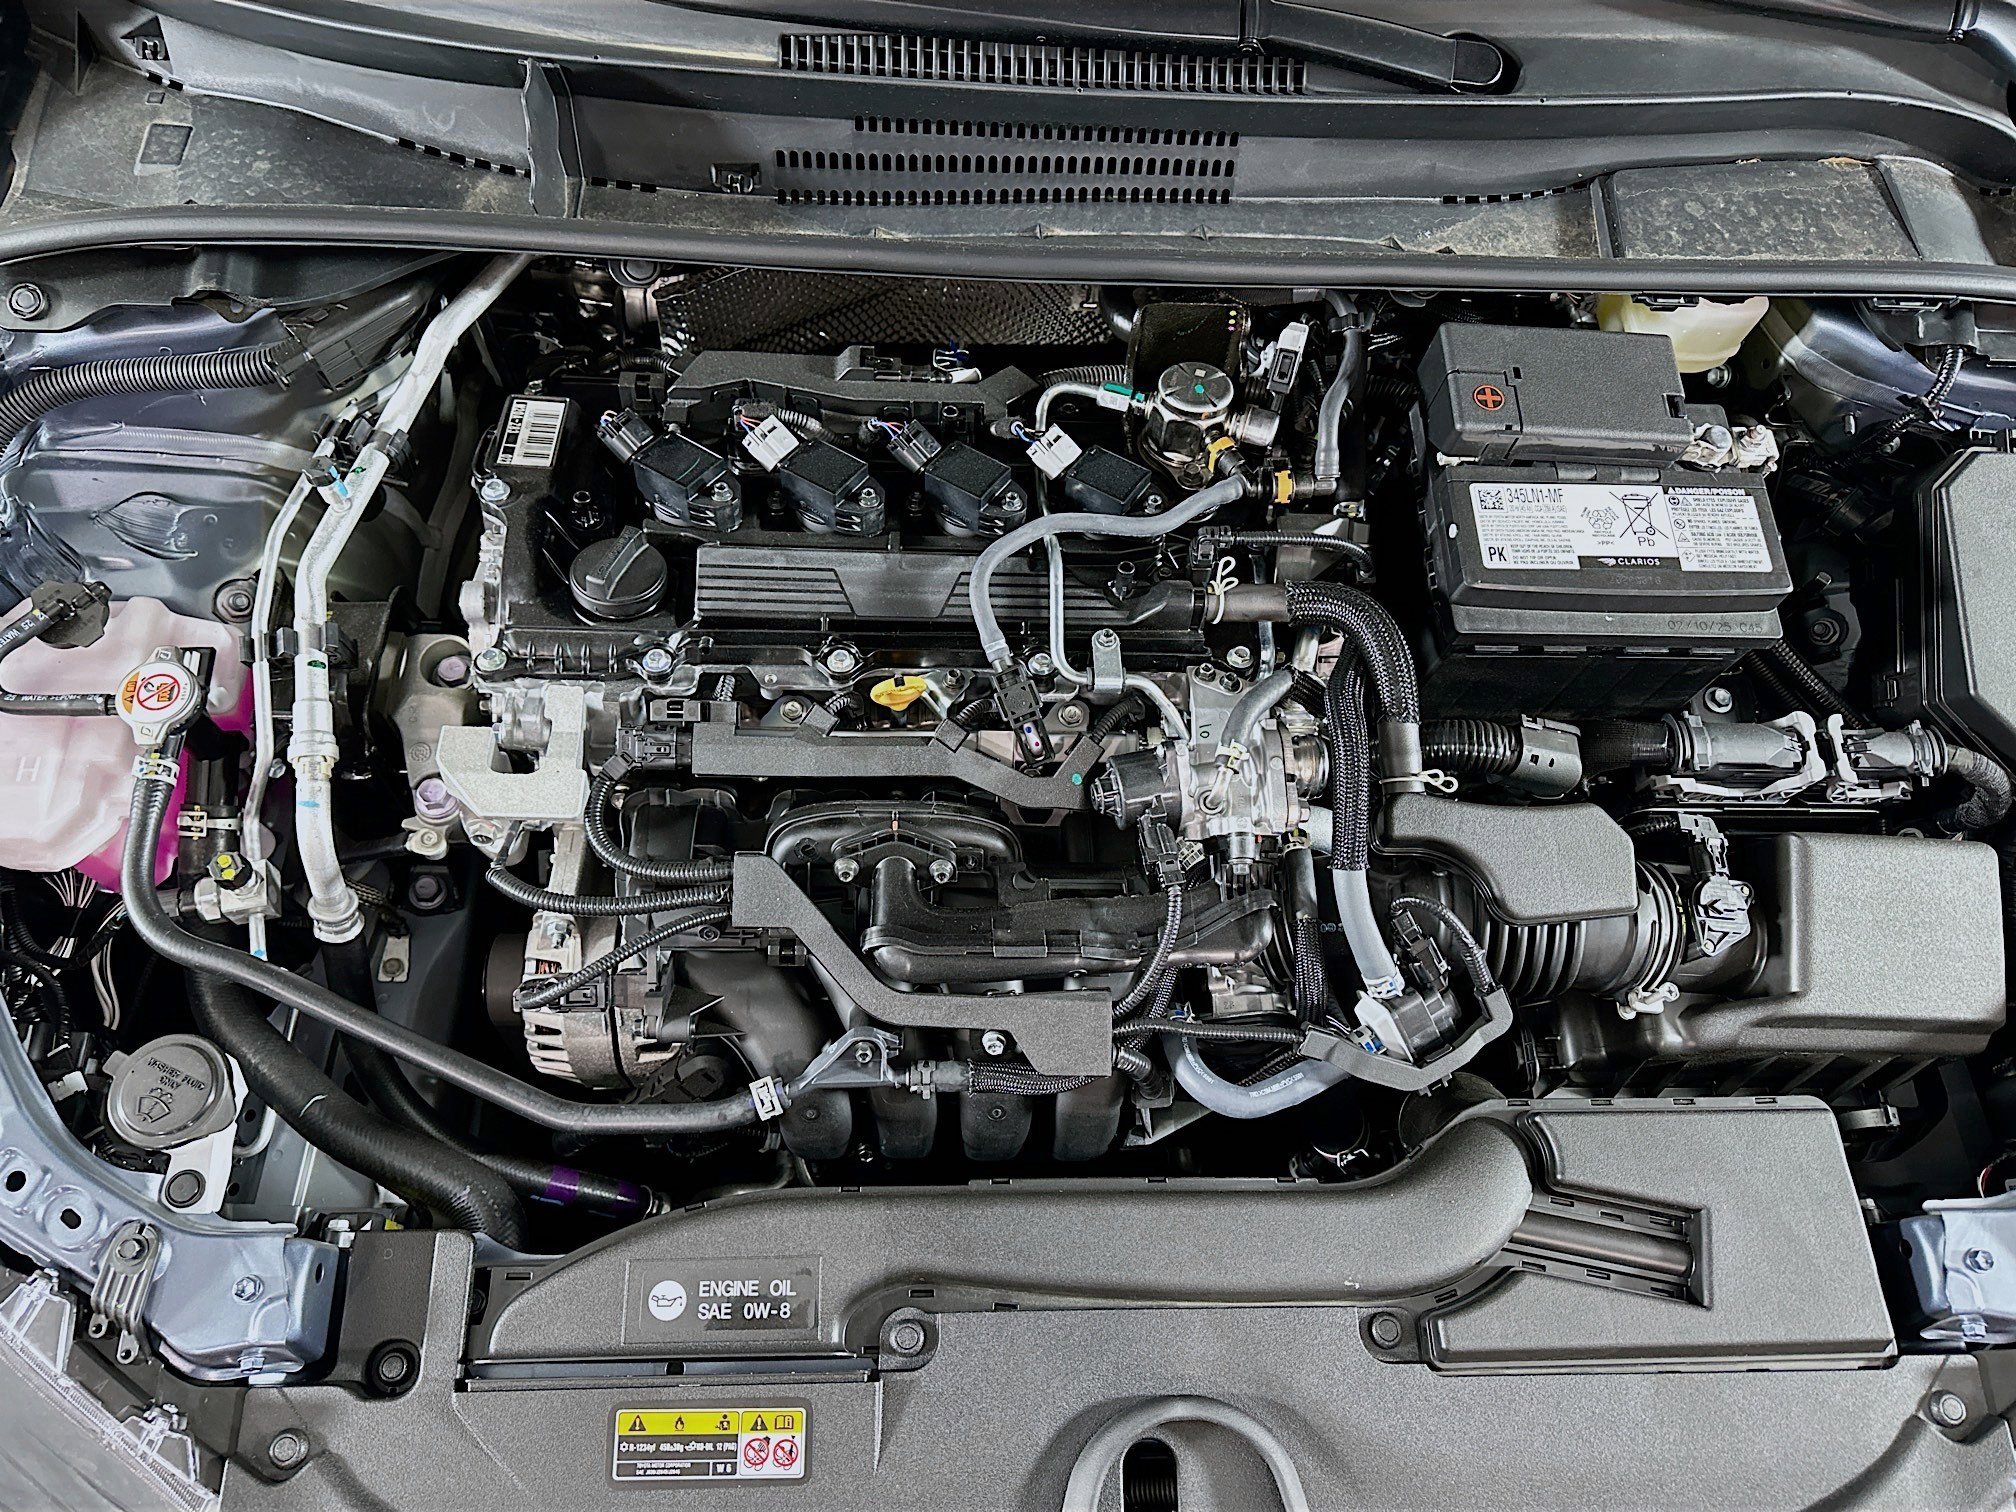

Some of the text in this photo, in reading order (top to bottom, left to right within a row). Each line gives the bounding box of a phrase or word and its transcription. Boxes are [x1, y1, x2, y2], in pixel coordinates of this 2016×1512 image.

[1506, 487, 1563, 503] 345LN1-MF
[1637, 536, 1656, 547] Pb
[1488, 546, 1508, 562] PK
[1617, 558, 1660, 566] CLARIOS
[698, 1279, 797, 1297] ENGINE OIL
[697, 1302, 791, 1320] SAE 0W-8
